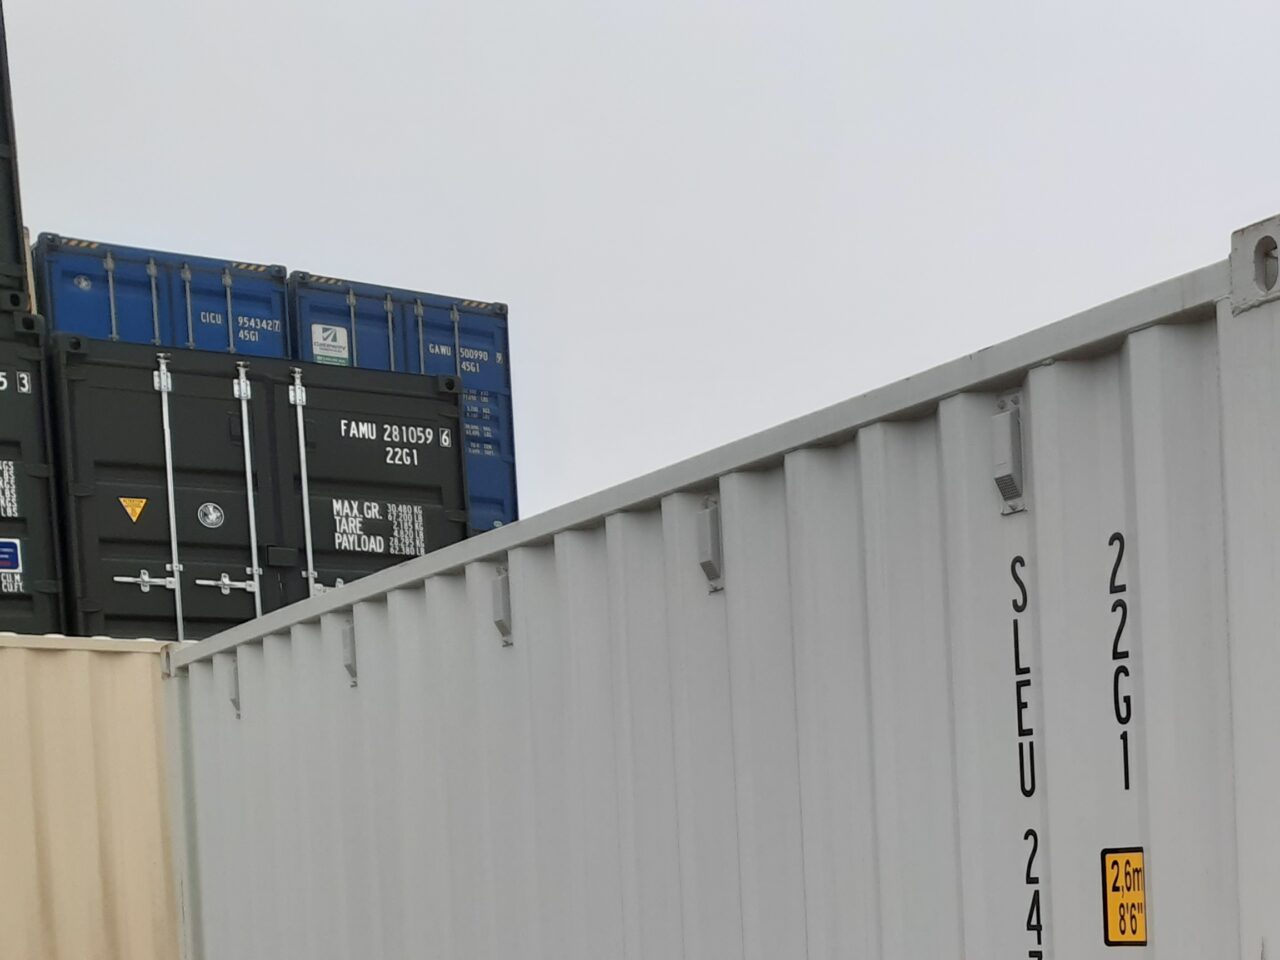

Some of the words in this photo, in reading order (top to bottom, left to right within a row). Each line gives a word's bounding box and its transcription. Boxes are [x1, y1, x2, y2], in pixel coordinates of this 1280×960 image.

[200, 311, 222, 325] CICU
[238, 329, 260, 342] 45G1
[429, 343, 452, 356] GAWU
[461, 361, 480, 373] 45G1
[19, 372, 29, 393] 3
[340, 419, 377, 440] FAMU
[383, 424, 434, 444] 281059
[440, 429, 450, 447] 6
[385, 446, 418, 466] 22G1
[334, 516, 364, 535] TARE
[334, 532, 385, 553] PAYLOAD
[1108, 532, 1132, 791] 22G1
[1010, 555, 1036, 798] SLEU
[1111, 859, 1143, 899] 2,6m
[1118, 902, 1144, 936] 8'6"
